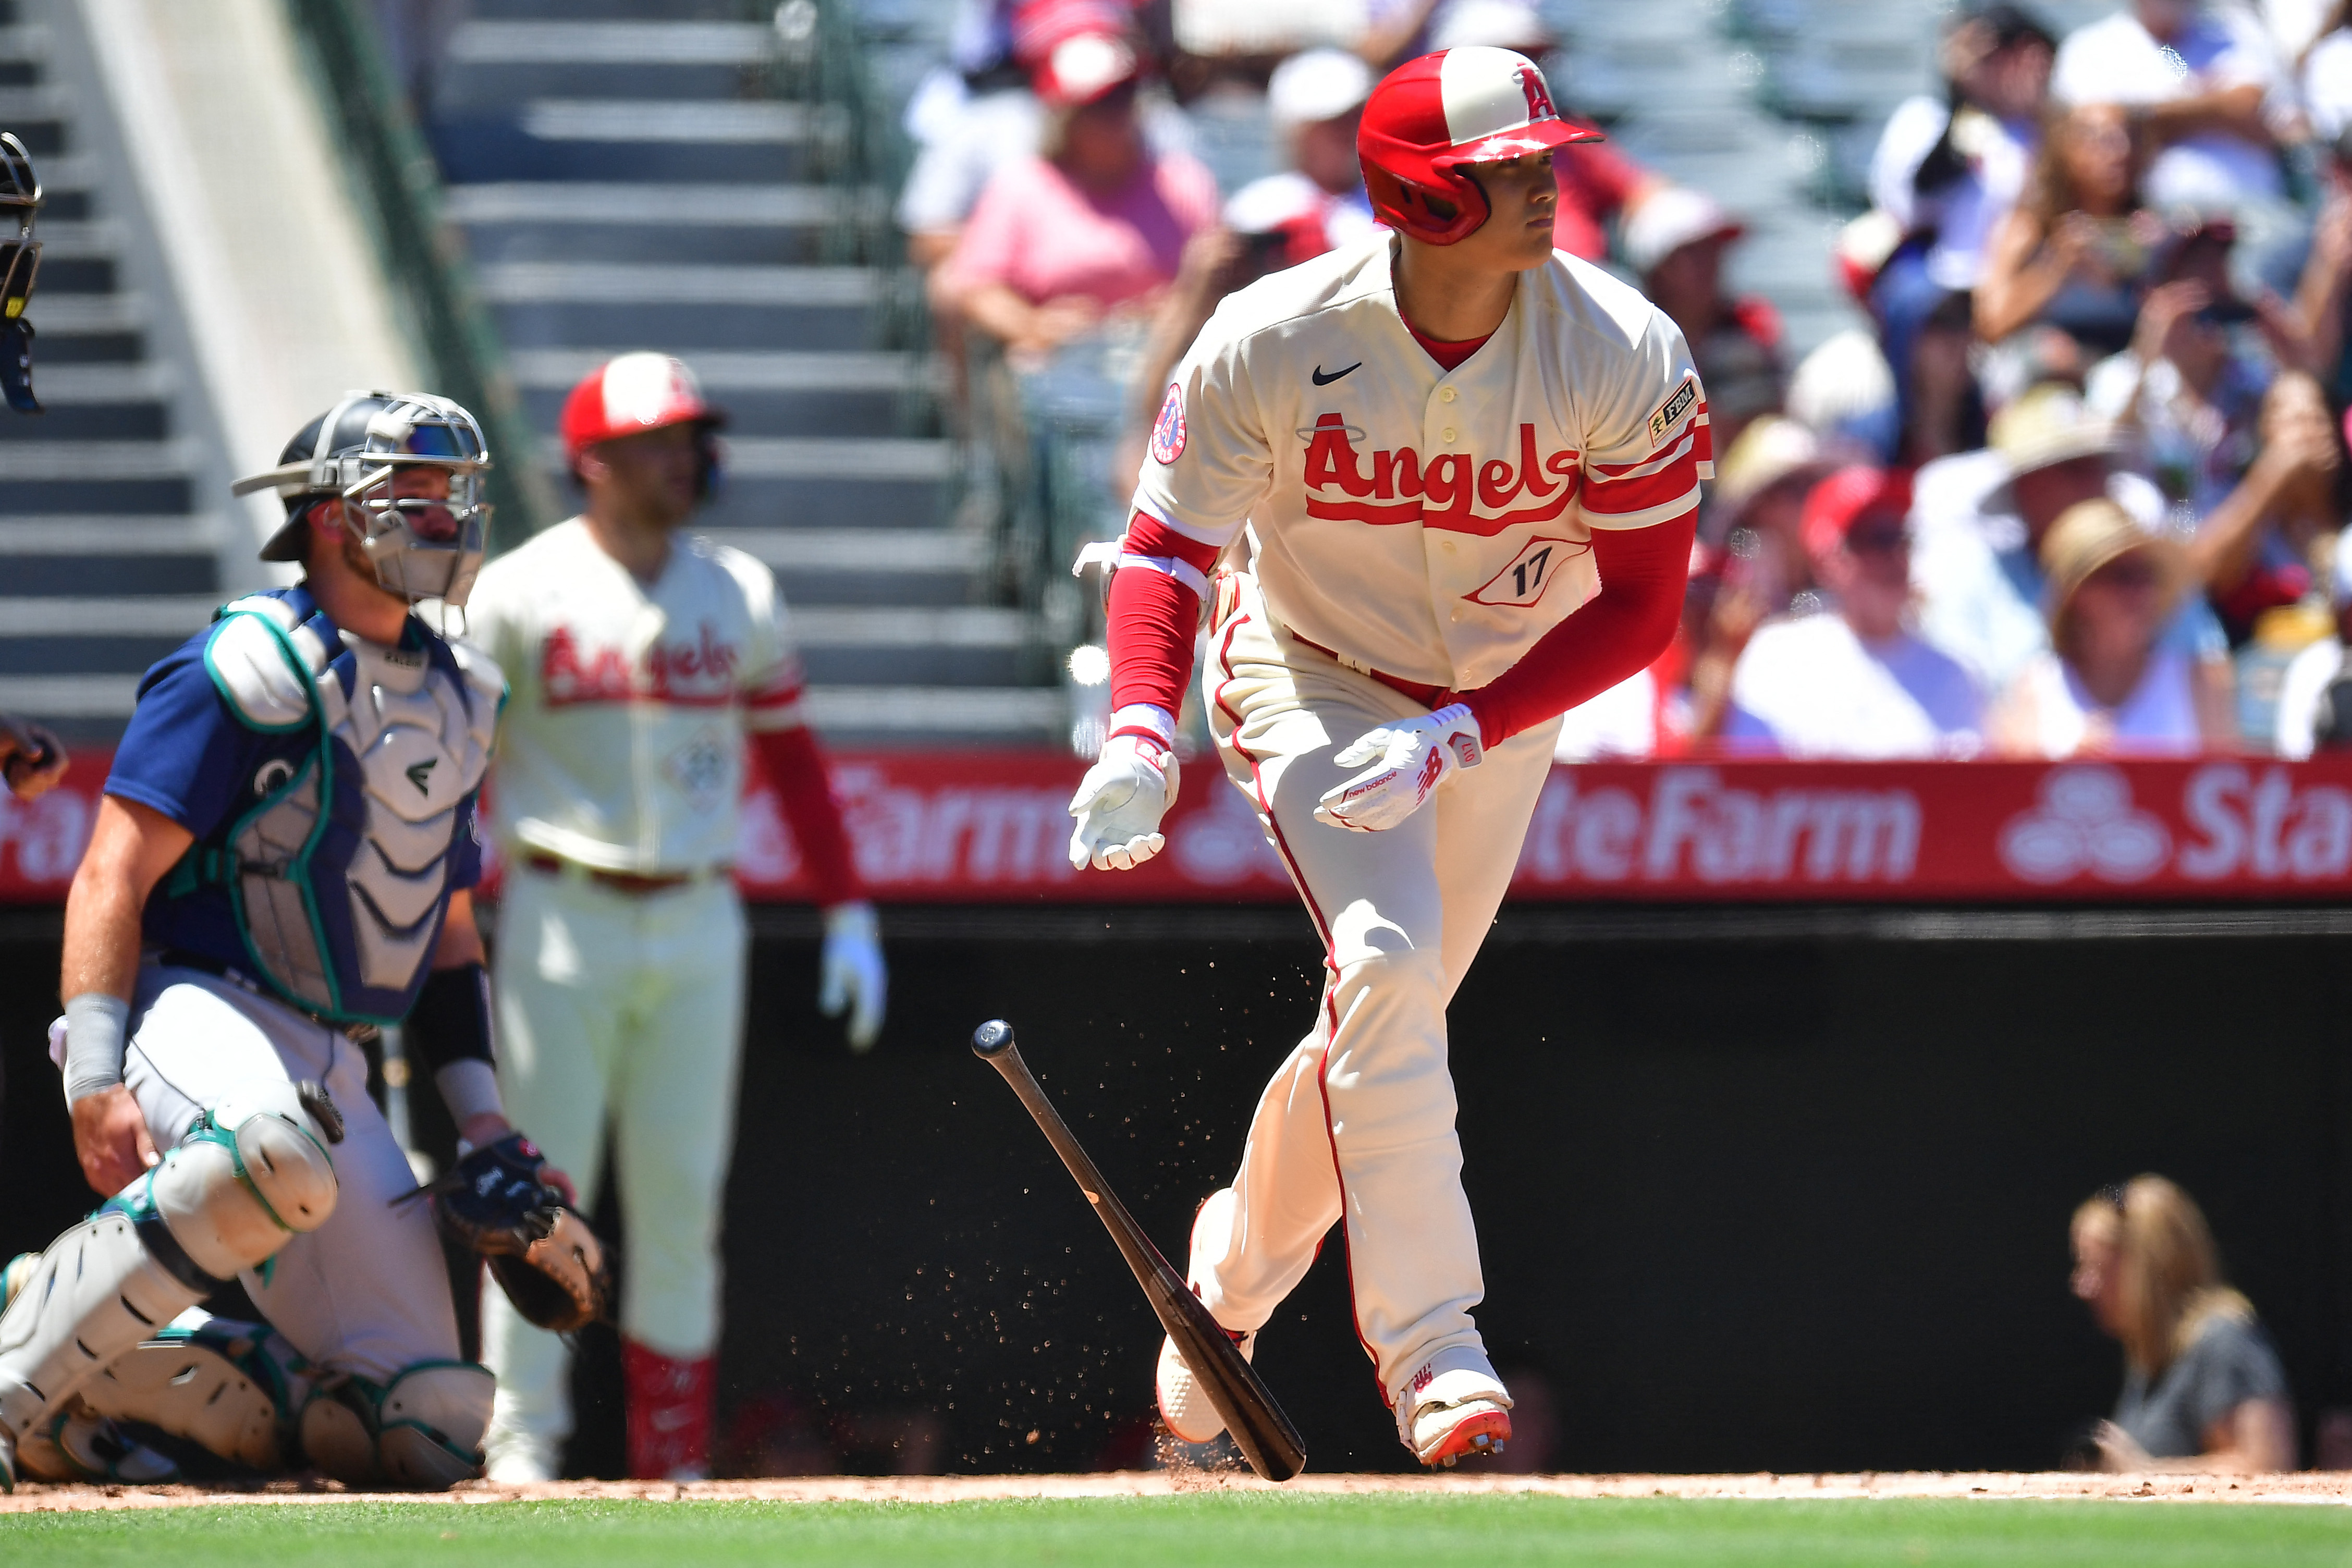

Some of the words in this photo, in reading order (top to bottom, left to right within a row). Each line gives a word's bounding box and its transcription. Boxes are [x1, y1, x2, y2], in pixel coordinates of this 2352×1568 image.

[1666, 385, 1693, 421] FBM
[1303, 412, 1580, 535] Angels
[1512, 545, 1552, 597] 17
[1349, 787, 1365, 798] new
[1366, 770, 1398, 792] balance
[2178, 763, 2352, 882] Sta
